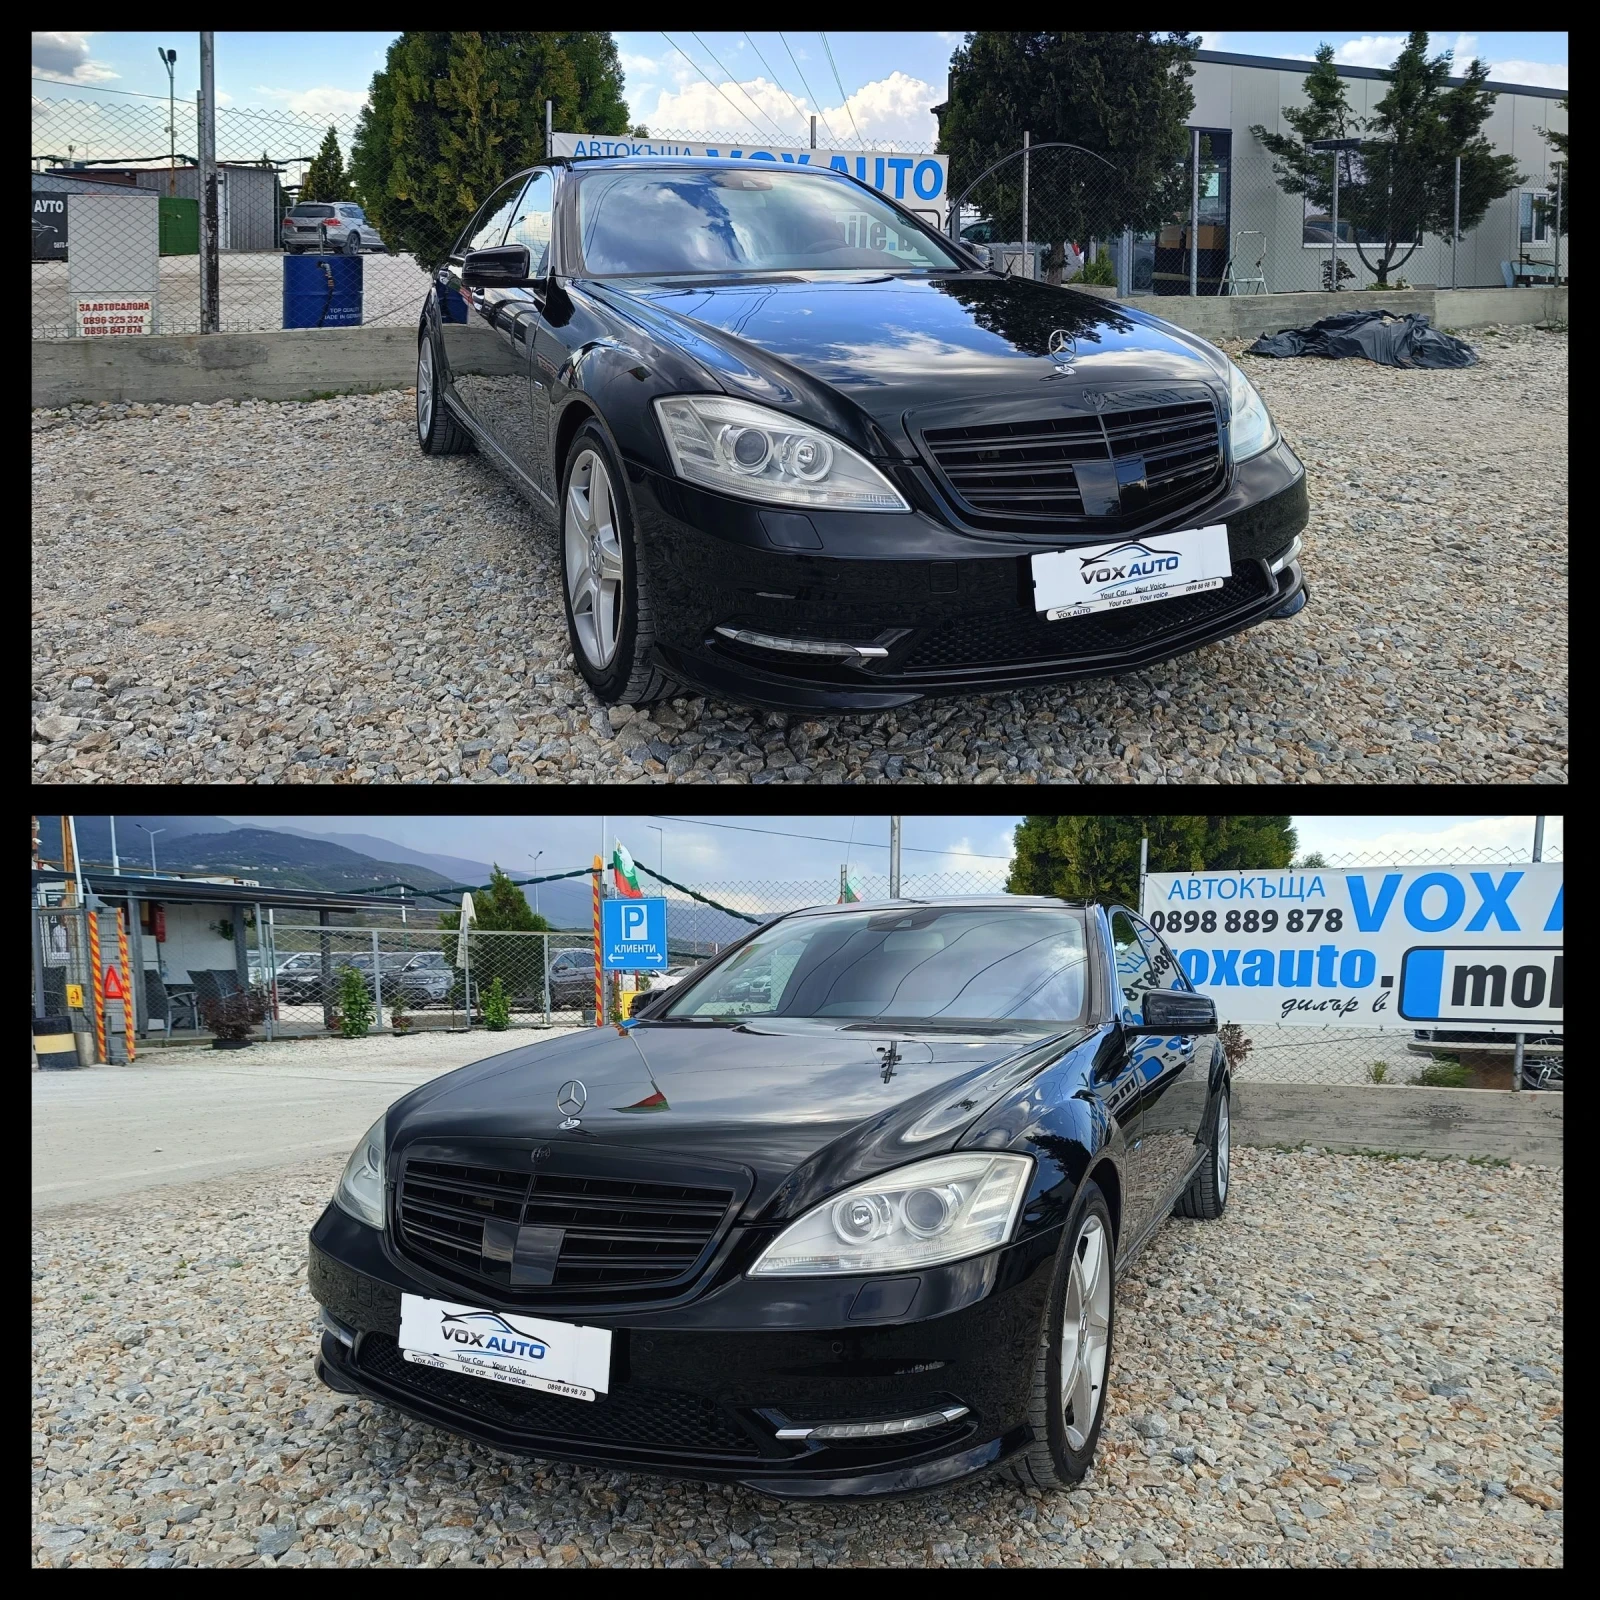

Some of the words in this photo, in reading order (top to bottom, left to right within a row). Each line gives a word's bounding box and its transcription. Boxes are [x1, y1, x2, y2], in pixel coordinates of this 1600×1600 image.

[34, 199, 64, 213] АУТО
[79, 303, 91, 312] ЗА
[92, 302, 150, 312] АВТОСАЛОНА
[83, 316, 107, 325] 0896
[108, 315, 126, 324] 325
[127, 315, 144, 324] 324
[1081, 565, 1127, 585] VOX
[1127, 556, 1178, 578] AUTO
[1100, 591, 1115, 599] Your
[1108, 599, 1122, 608] Your
[1139, 594, 1153, 602] Your
[1057, 611, 1072, 619] VOX
[1072, 607, 1091, 616] AUTO
[1167, 876, 1326, 902] АВТОКЪЩА
[1345, 871, 1525, 932] VOX
[1150, 909, 1218, 933] 0898
[1224, 909, 1279, 933] 889
[1286, 908, 1343, 933] 878
[614, 944, 656, 953] КЛИЕНТИ
[1281, 996, 1359, 1018] дилър
[441, 1325, 485, 1347] VOX
[485, 1336, 546, 1359] AUTO
[413, 1356, 426, 1364] VOX
[426, 1359, 445, 1368] AUTO
[457, 1353, 471, 1363] Your
[461, 1365, 474, 1373] Your
[493, 1372, 508, 1381] Your
[547, 1383, 562, 1392] 0898
